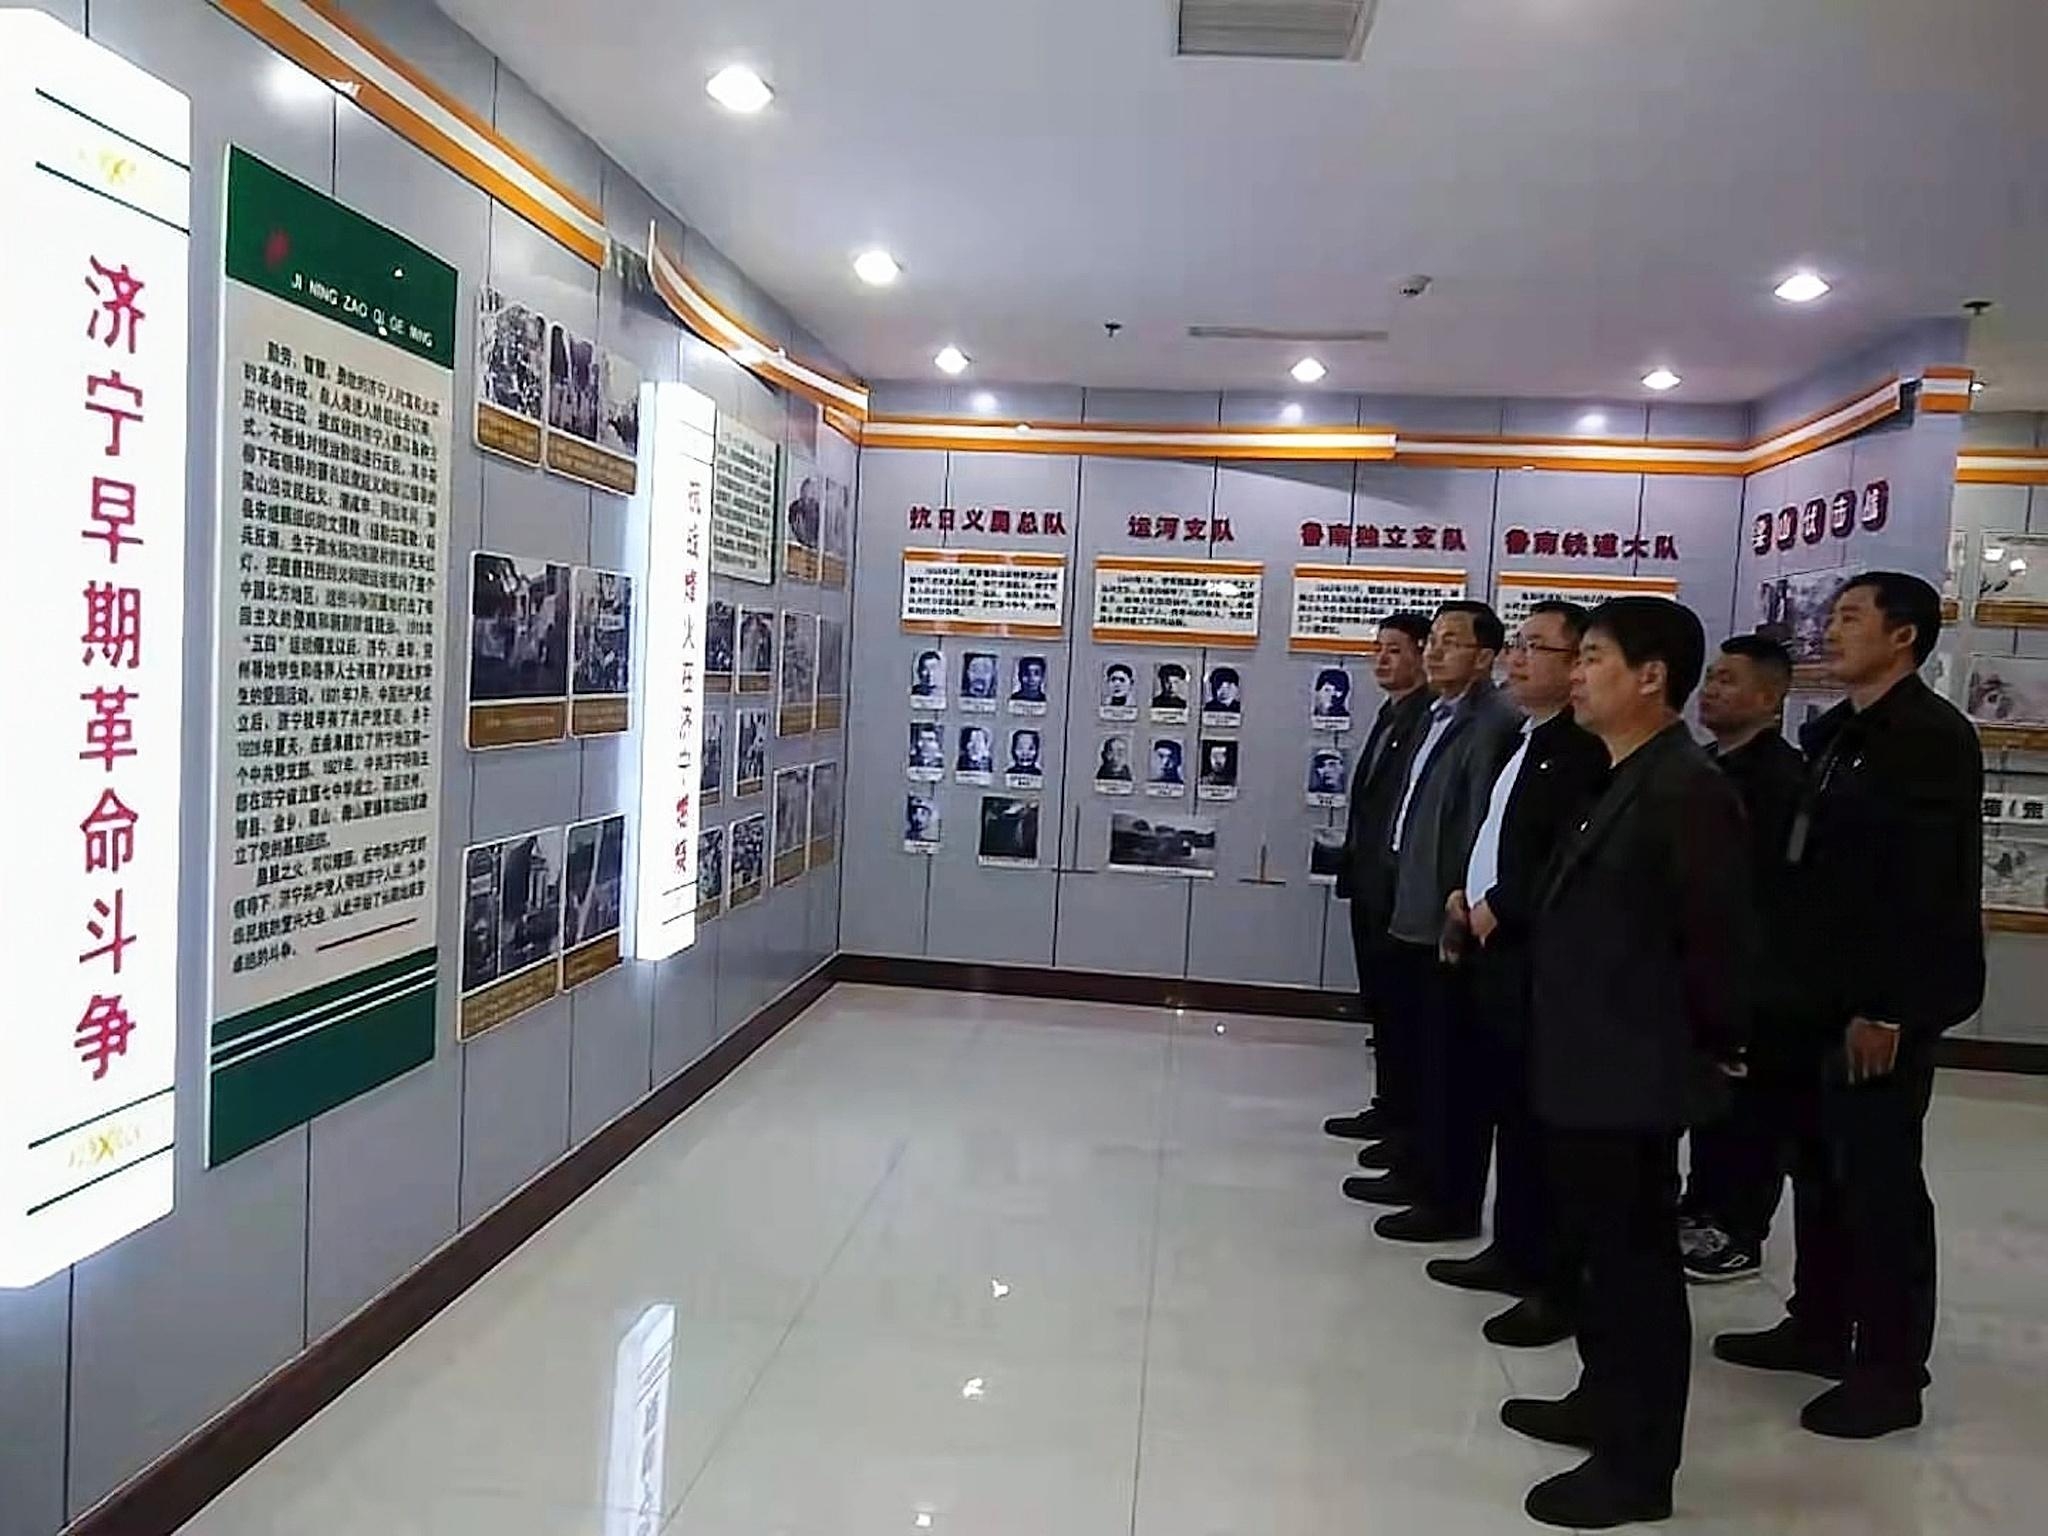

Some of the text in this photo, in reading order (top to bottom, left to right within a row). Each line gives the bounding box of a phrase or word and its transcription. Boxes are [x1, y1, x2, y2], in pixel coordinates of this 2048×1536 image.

[290, 273, 303, 291] JI
[309, 279, 338, 306] NING
[342, 294, 368, 318] ZAO
[373, 308, 385, 326] QI
[909, 505, 1067, 535] 抗日义勇总队
[1128, 513, 1235, 542] 运河支队
[1300, 521, 1467, 552] 鲁南独立支队
[1504, 527, 1680, 560] 鲁南铁道大队
[74, 254, 146, 1081] 济宁早期革命斗争
